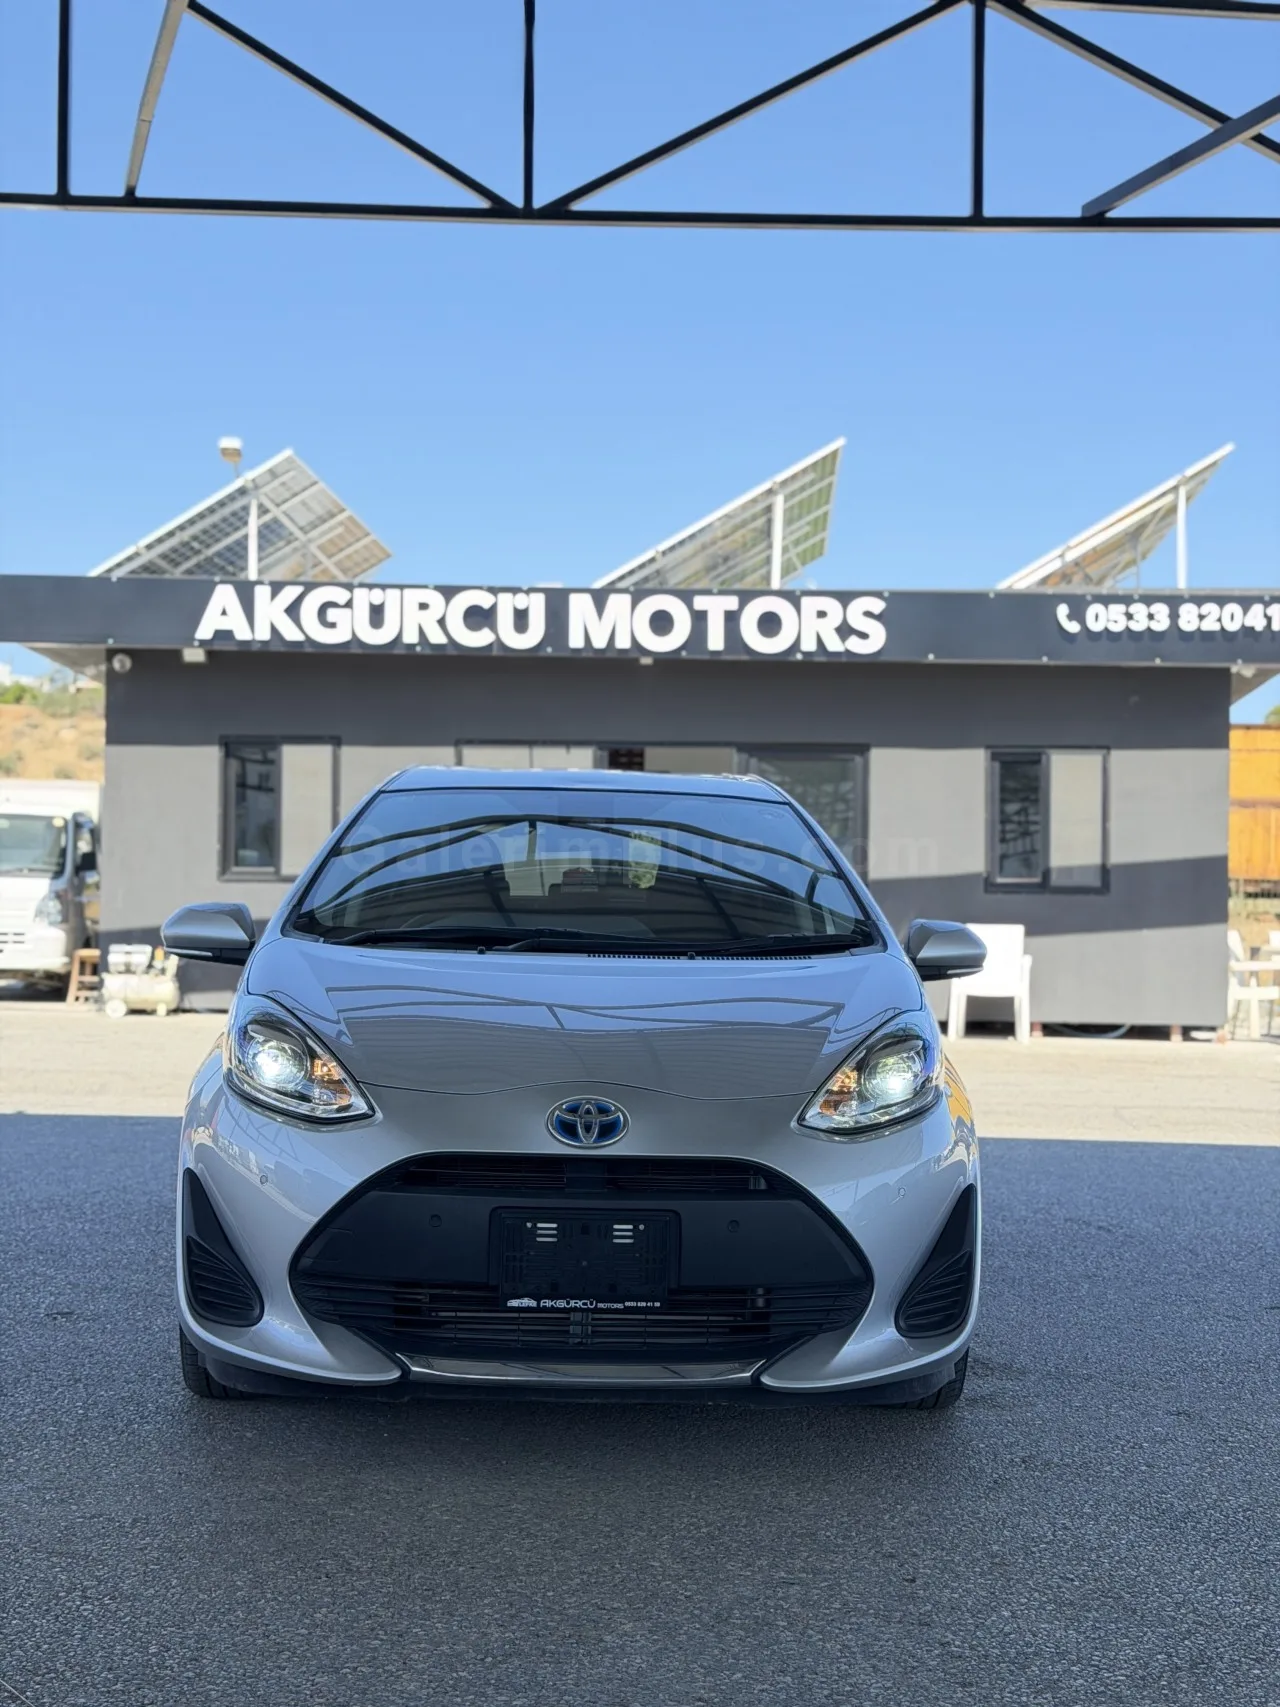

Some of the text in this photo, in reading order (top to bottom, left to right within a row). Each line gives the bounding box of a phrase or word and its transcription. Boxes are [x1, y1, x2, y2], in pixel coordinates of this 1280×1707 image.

[194, 583, 888, 655] AKGÜRCÜ MOTORS
[1085, 602, 1280, 633] 0533 82041
[540, 1298, 596, 1309] AKGÜRCÜ
